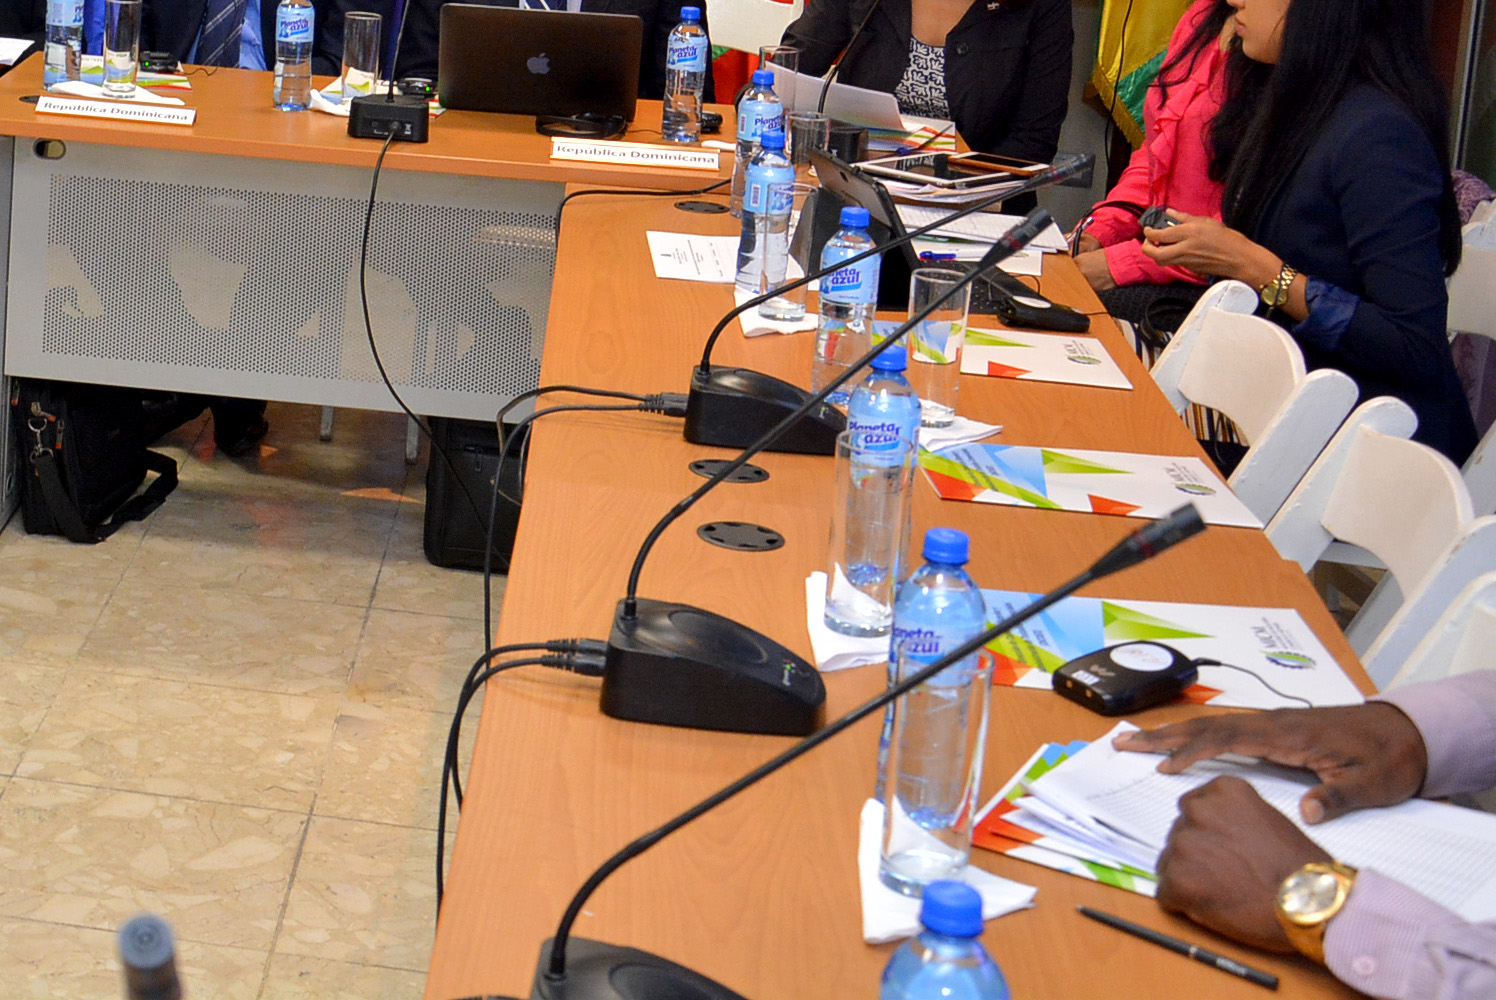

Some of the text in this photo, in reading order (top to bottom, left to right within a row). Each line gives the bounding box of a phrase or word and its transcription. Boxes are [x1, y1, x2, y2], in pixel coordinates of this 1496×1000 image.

[677, 48, 697, 58] azul
[44, 102, 188, 121] República Dominicana
[557, 146, 715, 163] República Dominicana
[832, 272, 860, 285] azul
[849, 421, 895, 432] Planeta
